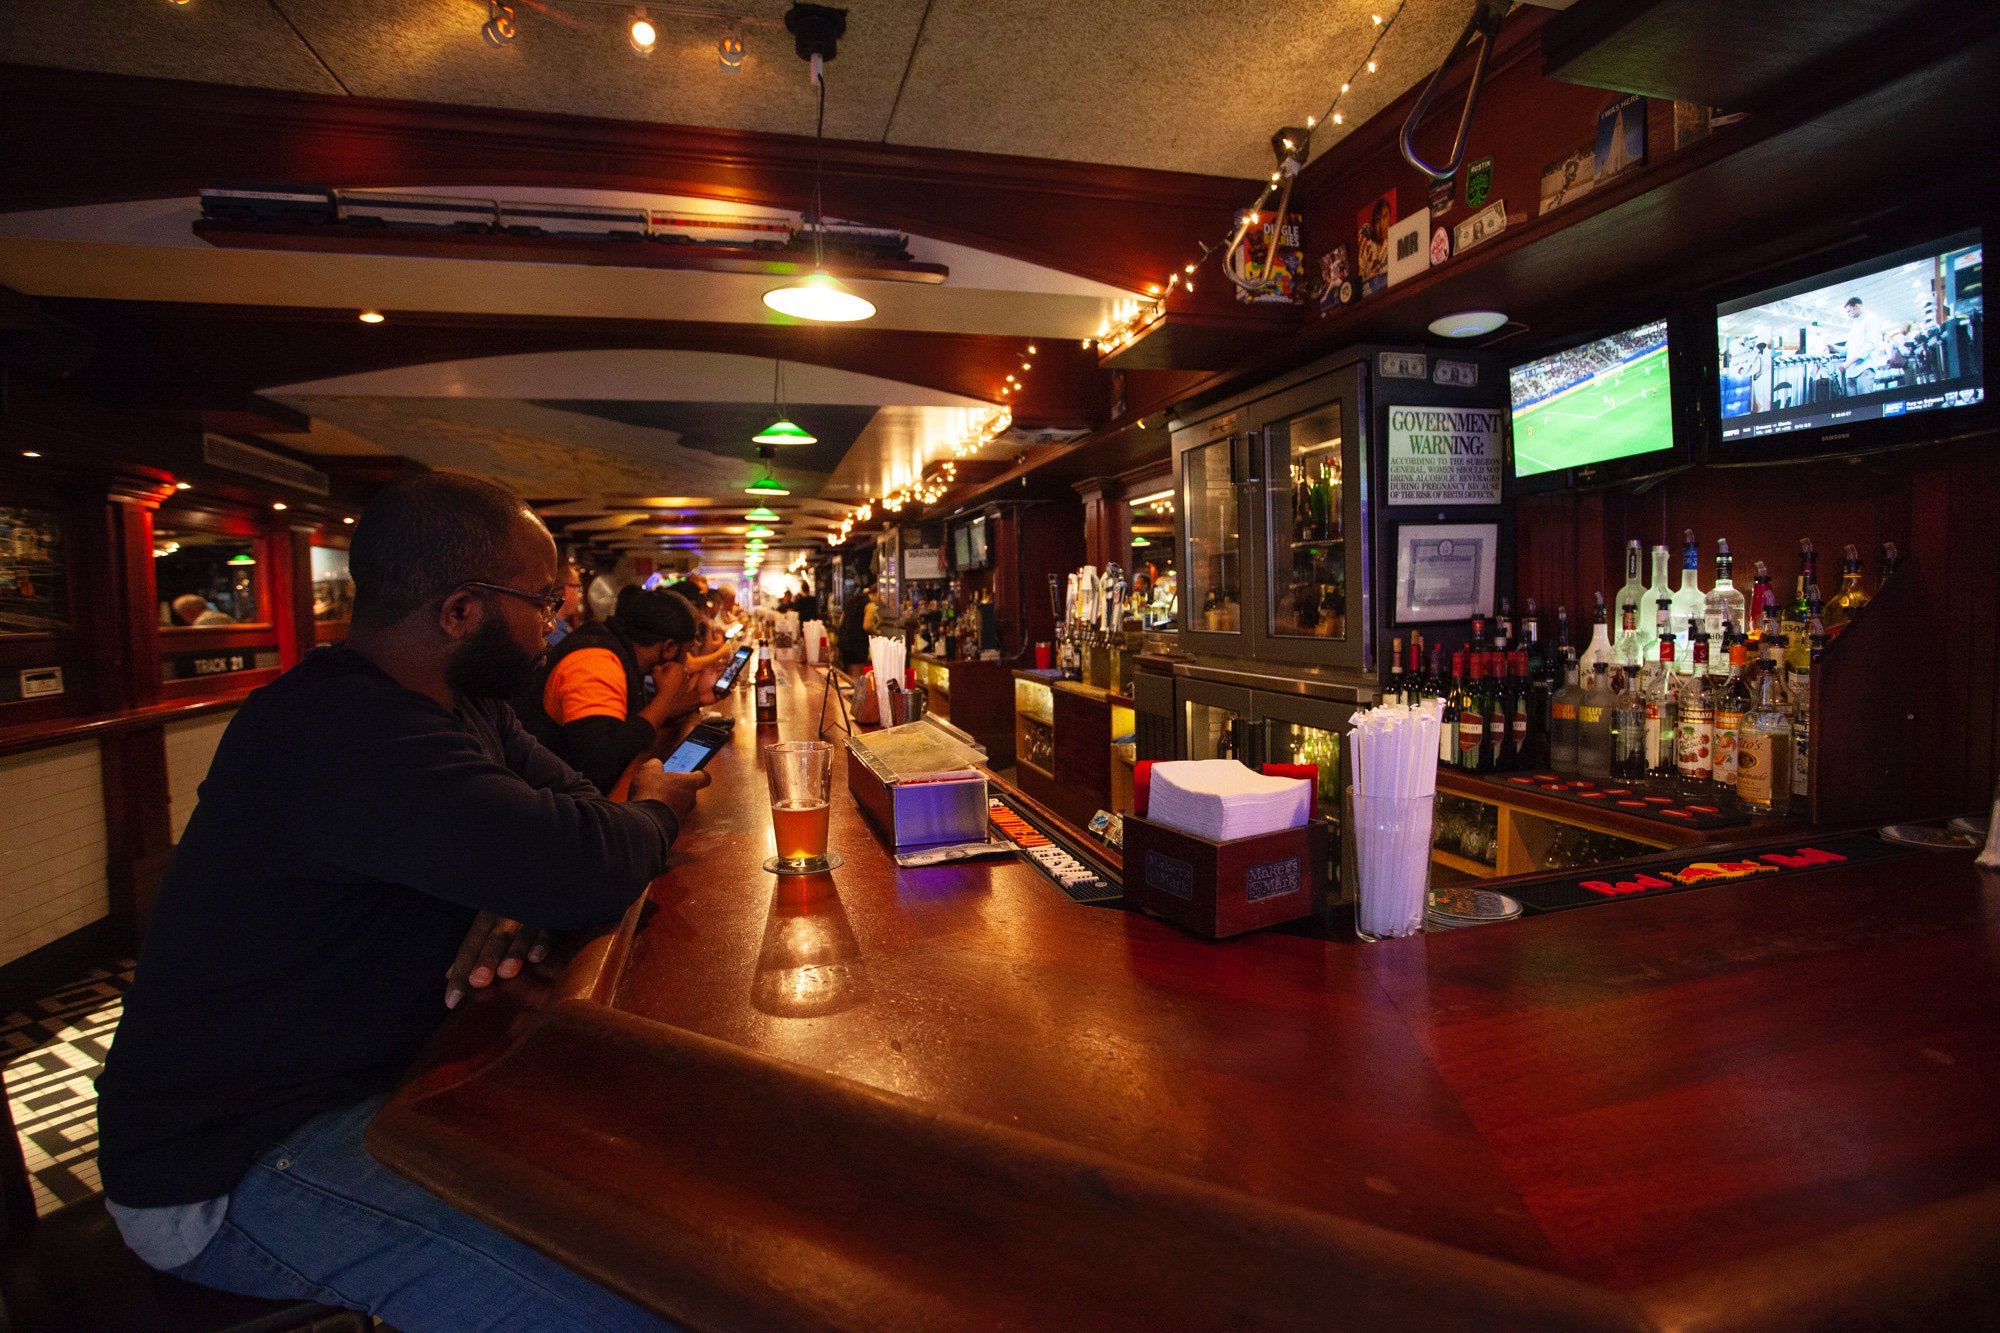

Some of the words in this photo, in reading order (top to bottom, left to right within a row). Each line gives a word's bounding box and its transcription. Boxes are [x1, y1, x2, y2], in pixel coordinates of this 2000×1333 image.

[1263, 223, 1300, 237] DIGLE
[1392, 410, 1501, 434] GOVERNMENT
[1409, 434, 1484, 456] WARNING:
[1391, 457, 1435, 466] ACCORDING
[1438, 457, 1448, 466] TO
[1450, 457, 1464, 466] THE
[1466, 457, 1501, 466] SURGEON
[1390, 466, 1427, 474] GENERAL,
[1428, 466, 1454, 474] WOMEN
[1456, 466, 1485, 474] SHOULD
[1487, 466, 1501, 474] NOT
[1390, 474, 1414, 482] DRINK
[1417, 474, 1458, 482] ALCOHOLIC
[1459, 474, 1501, 482] BEVERAGES
[1390, 482, 1420, 491] DURING
[1422, 482, 1465, 491] PREGNANCY
[1468, 482, 1500, 491] BECAUSE
[1390, 491, 1400, 499] OF
[1401, 491, 1415, 499] THE
[1416, 491, 1432, 499] RISK
[1433, 491, 1442, 499] OF
[1443, 491, 1464, 499] BIRTH
[194, 657, 227, 674] TRACK
[1740, 739, 1762, 751] ito's
[1250, 859, 1298, 881] Maker's
[1579, 873, 1674, 897] Red
[1759, 847, 1849, 868] Bull
[1262, 874, 1298, 894] Mark
